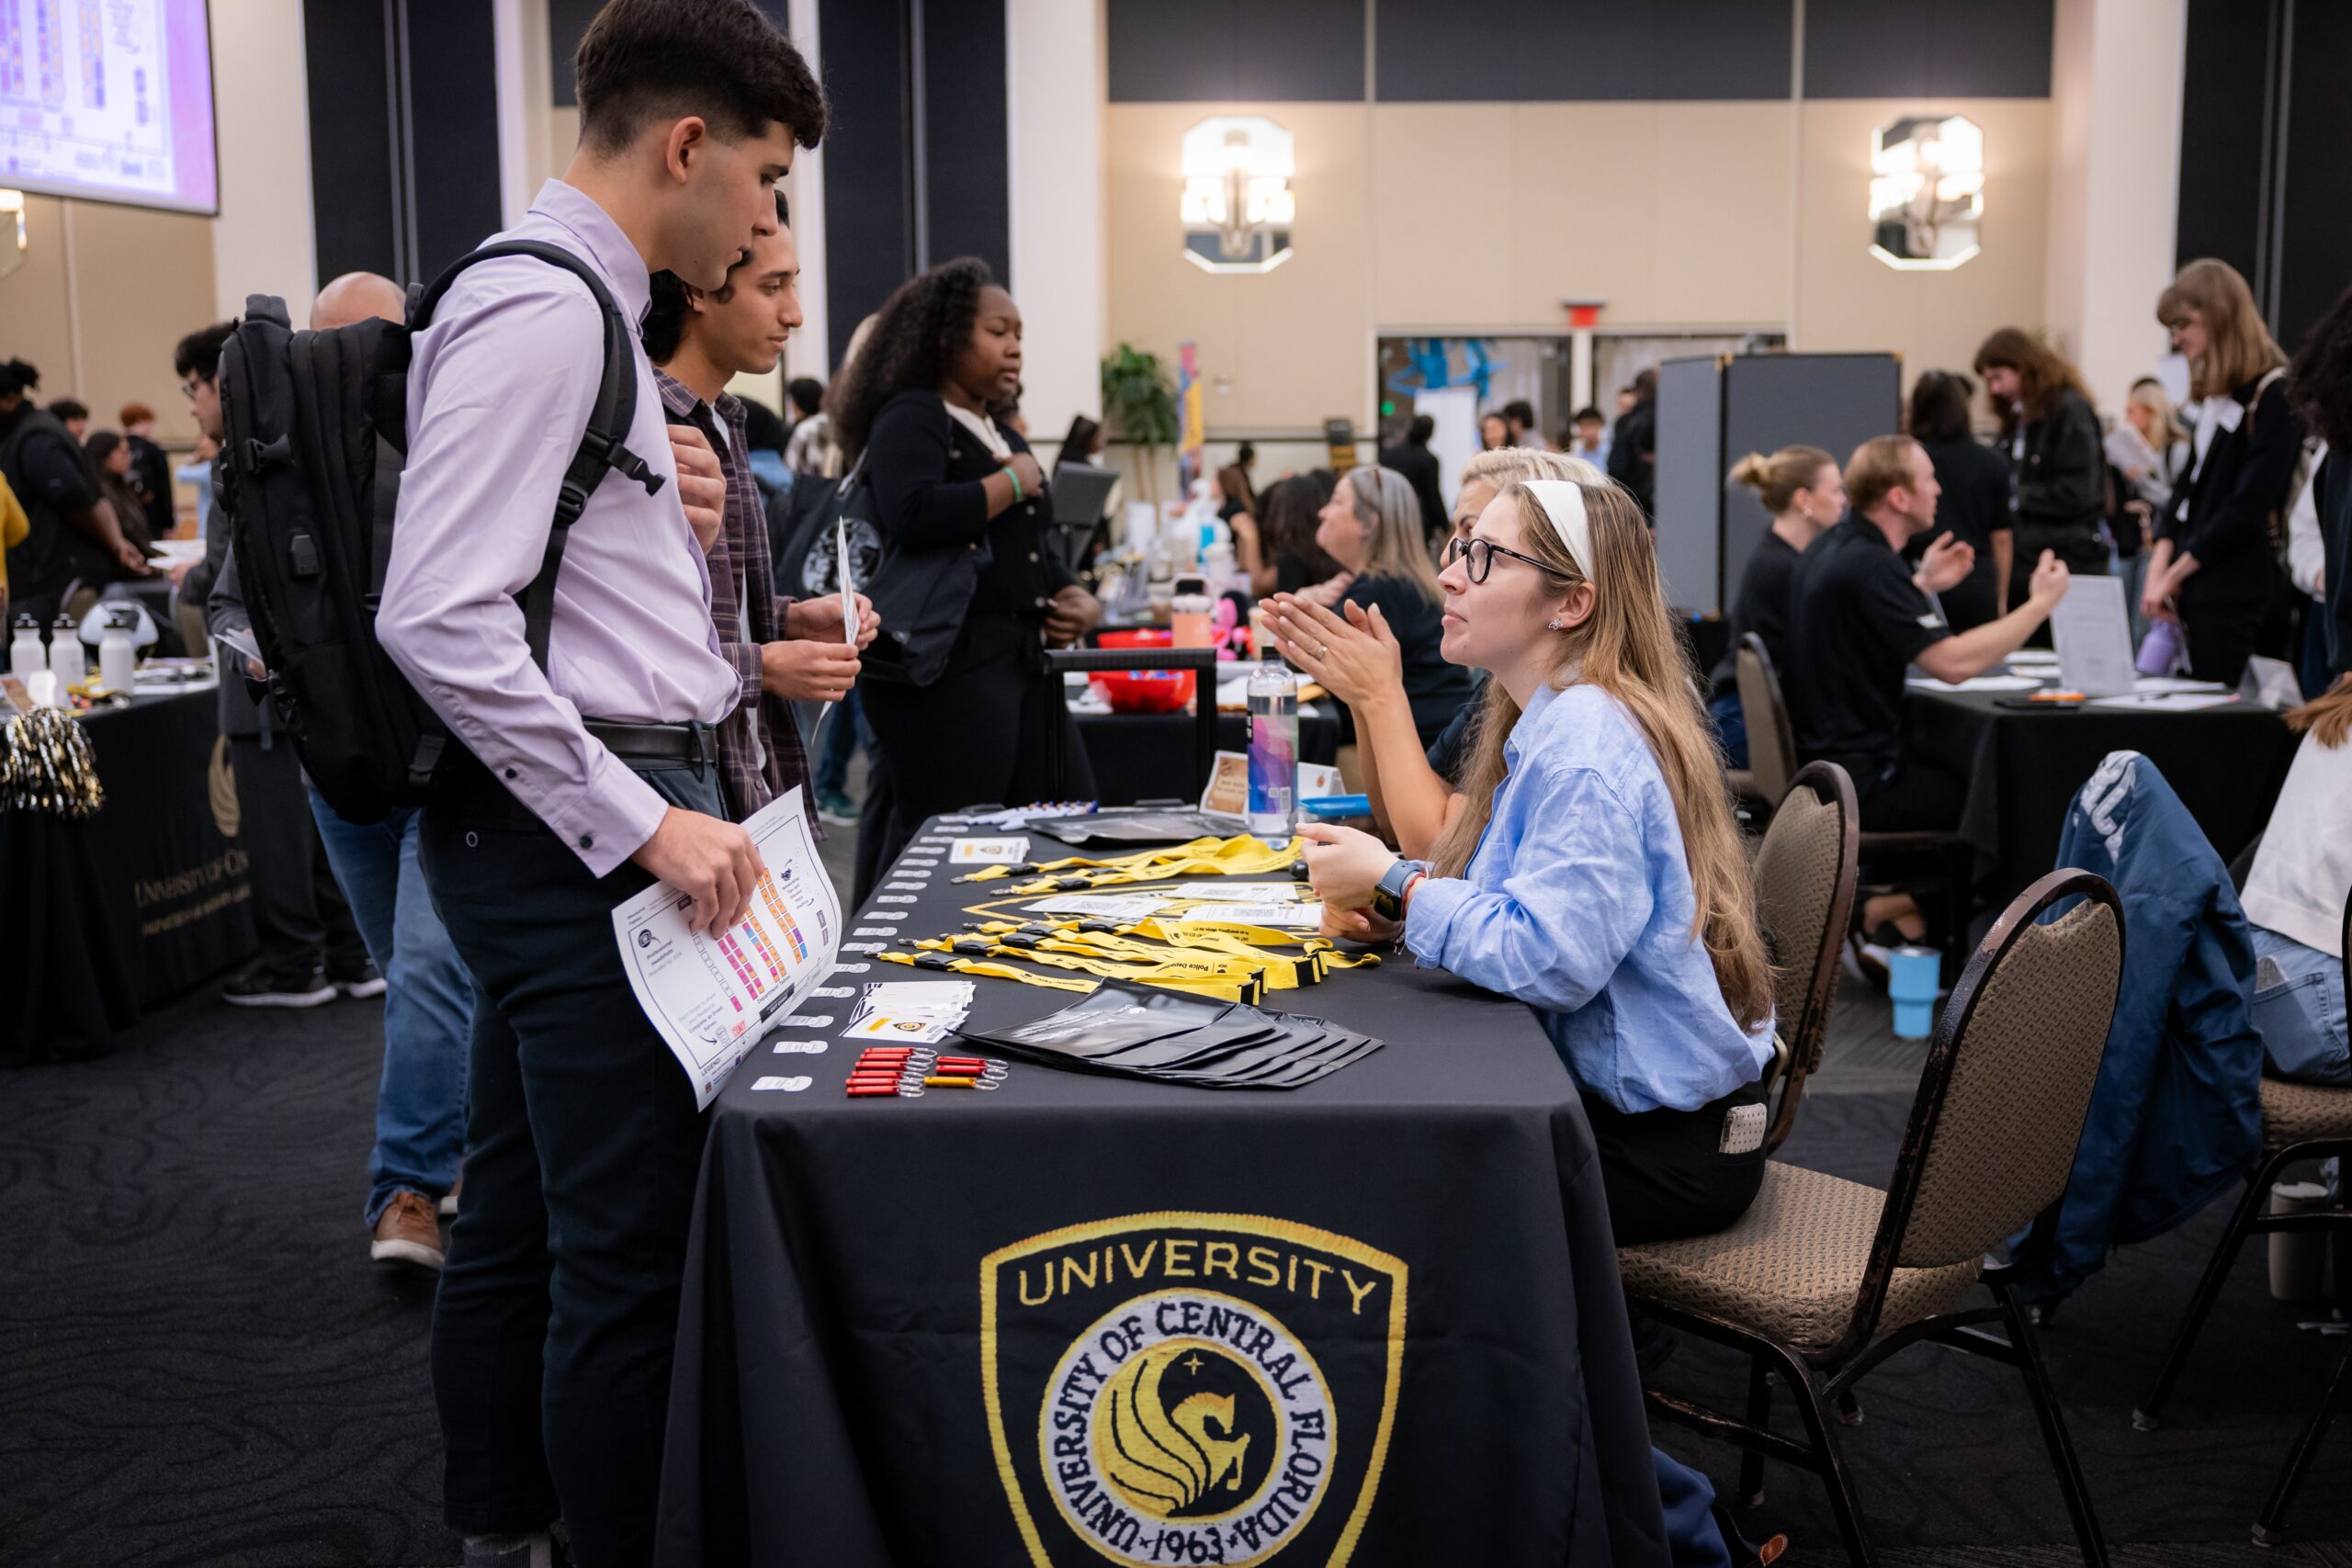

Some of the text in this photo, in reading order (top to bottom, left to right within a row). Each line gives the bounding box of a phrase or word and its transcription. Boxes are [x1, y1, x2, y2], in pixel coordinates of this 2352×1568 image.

[1188, 964, 1209, 972] Police
[1019, 1239, 1376, 1314] UNIVERSITY
[1053, 1302, 1326, 1552] UNIVERSITY OF CENTRAL FLORIDA
[1150, 1528, 1226, 1564] 1963
